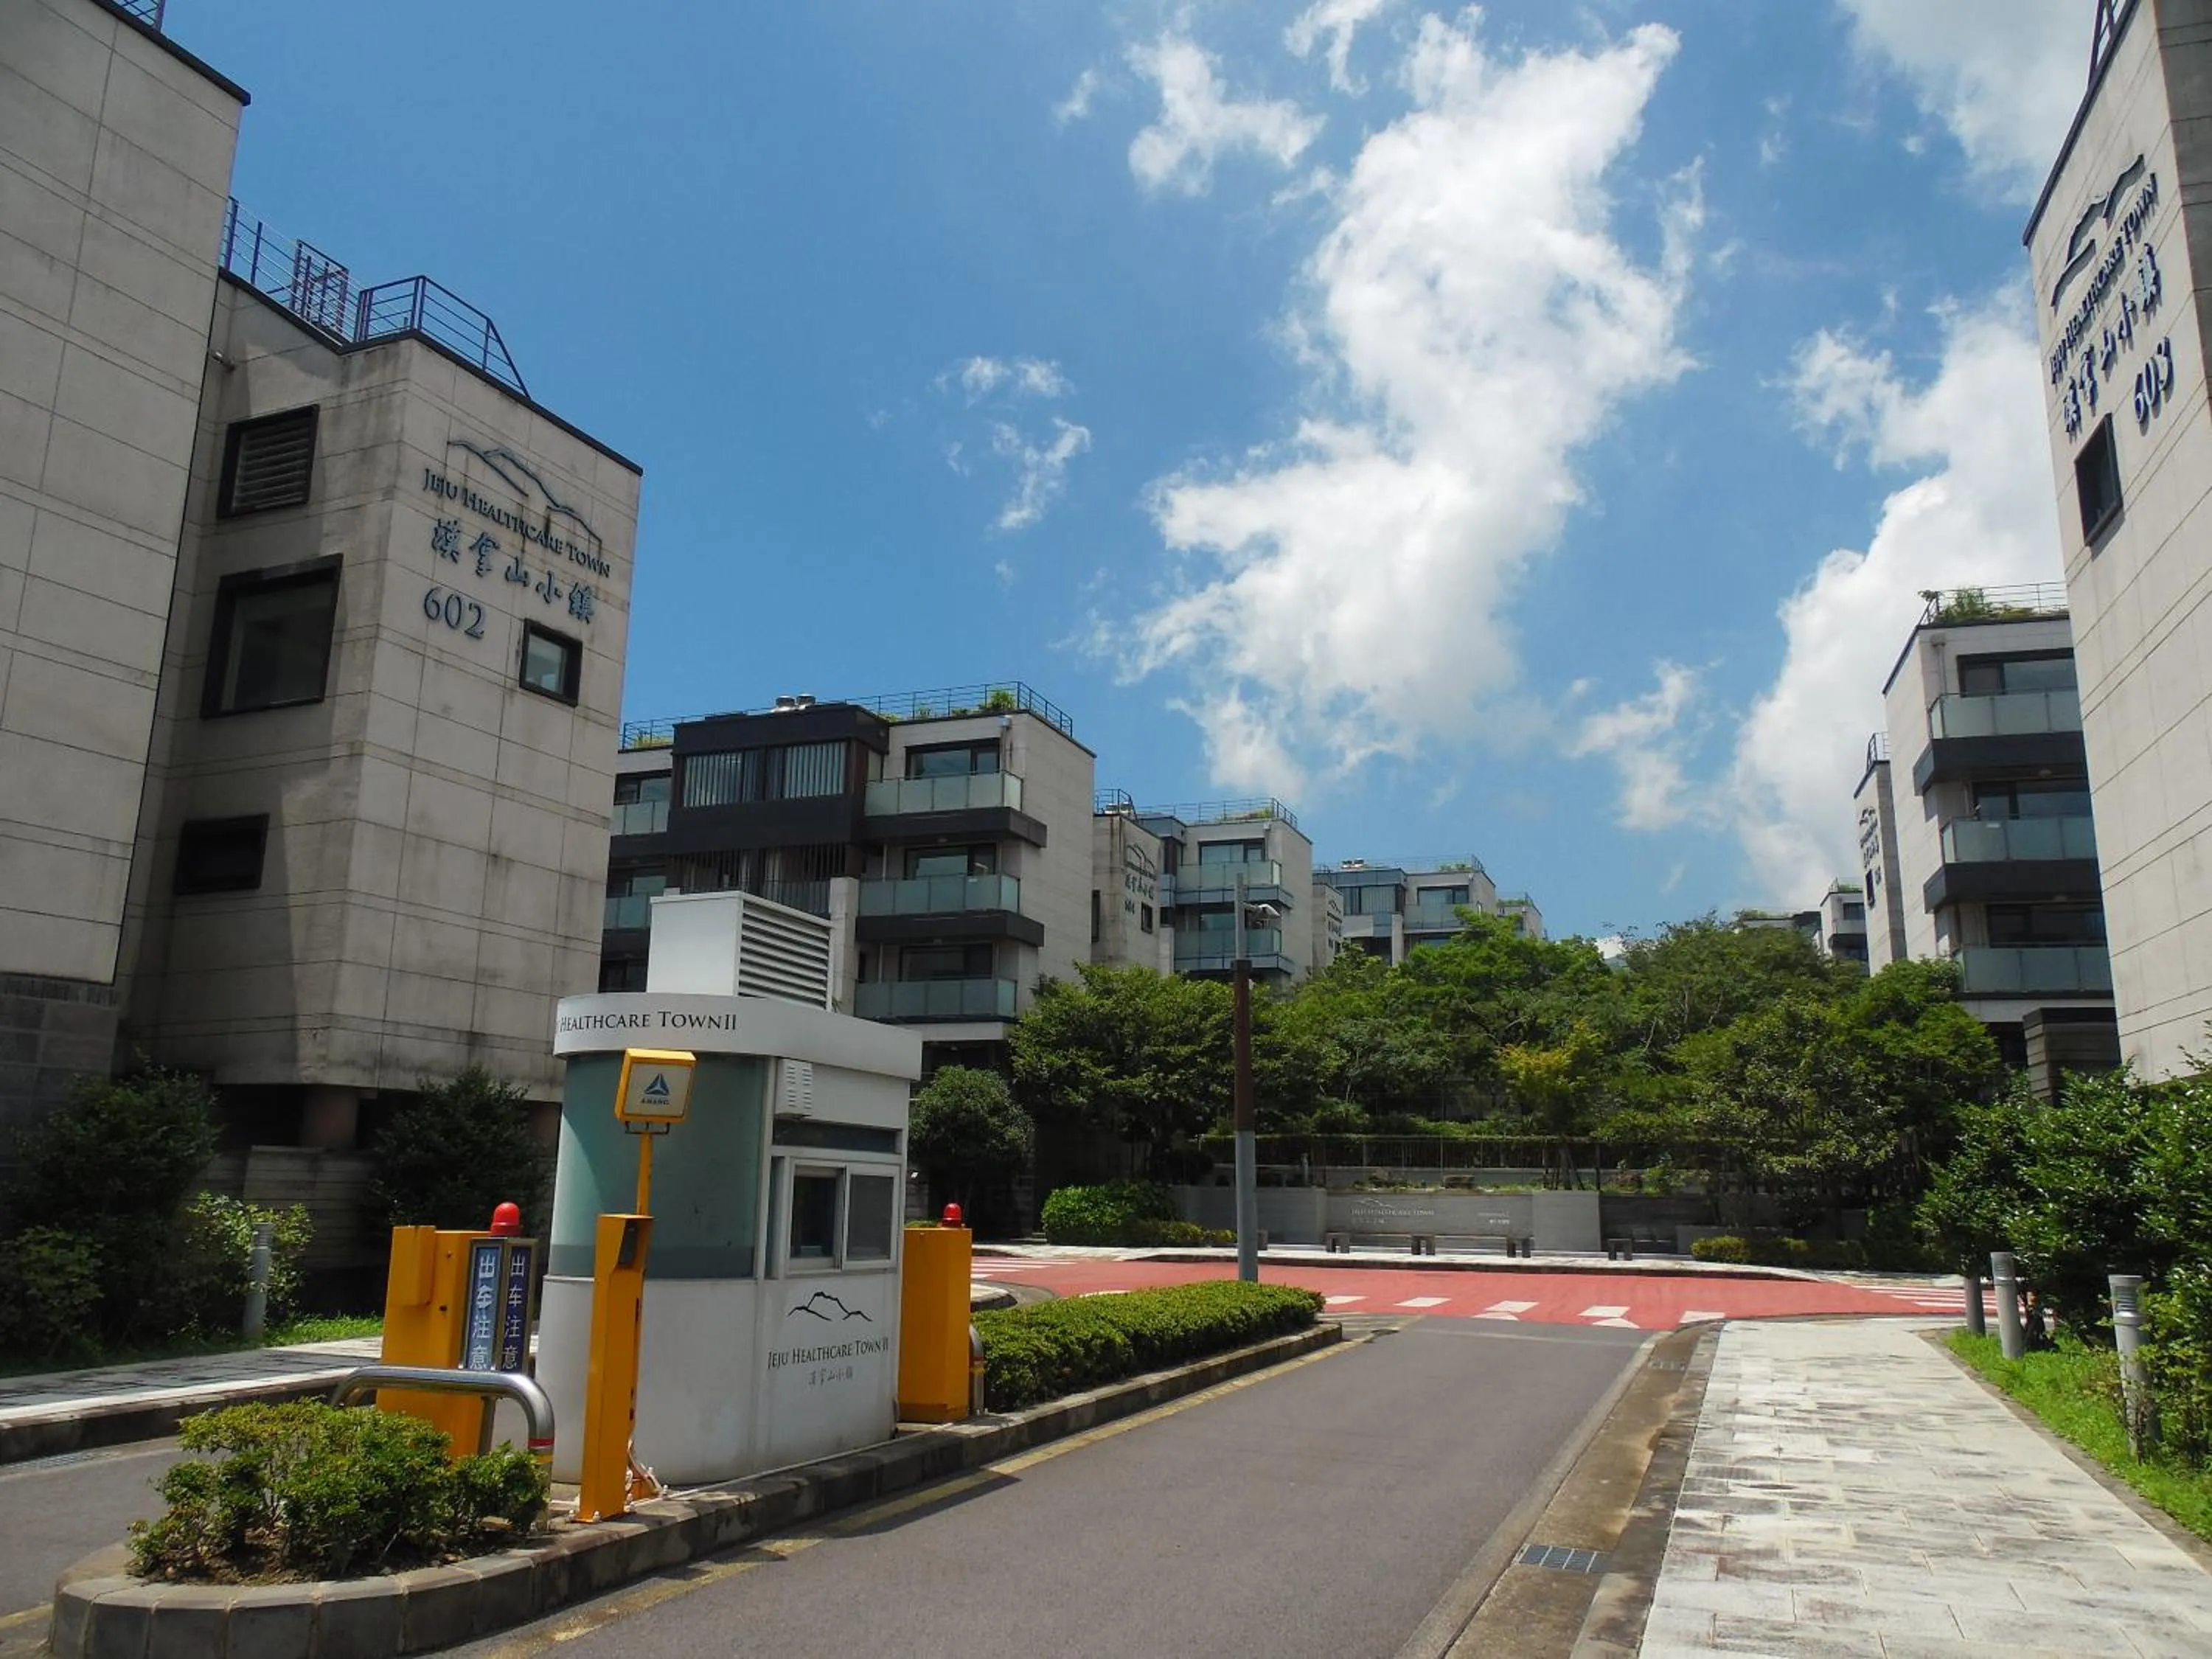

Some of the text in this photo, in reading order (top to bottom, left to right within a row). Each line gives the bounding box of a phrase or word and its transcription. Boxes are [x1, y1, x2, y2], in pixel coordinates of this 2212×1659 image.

[2135, 336, 2173, 426] 603
[422, 468, 611, 578] JEJU HEALTHCARE TOWN
[424, 586, 484, 639] 602
[560, 1014, 651, 1032] HEALTHCARE
[503, 1255, 526, 1369] 出车注意
[768, 1350, 790, 1369] JEJU
[792, 1343, 853, 1364] HEALTHCARE
